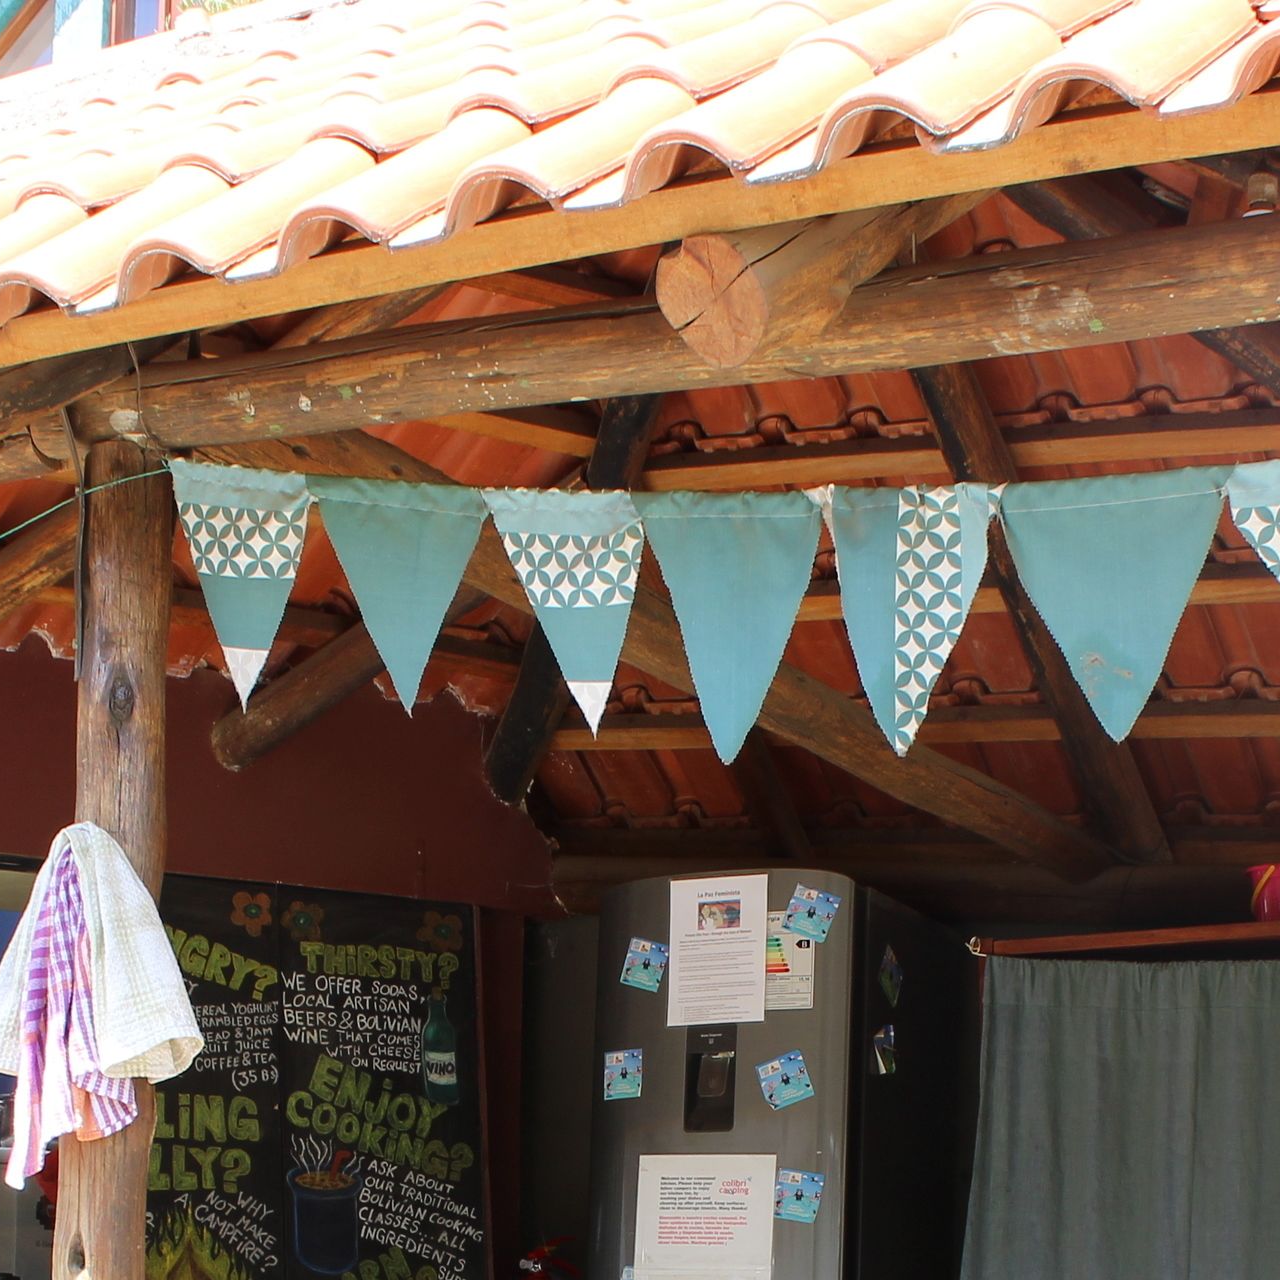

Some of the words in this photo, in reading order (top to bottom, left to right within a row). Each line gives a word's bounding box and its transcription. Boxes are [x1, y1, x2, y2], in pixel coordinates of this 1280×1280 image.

[281, 972, 306, 991] WE
[315, 975, 361, 994] OFFER
[283, 992, 334, 1008] LOCAL
[193, 1004, 227, 1016] EREAL
[284, 1009, 338, 1027] BEERS
[254, 1013, 278, 1025] EGGS
[235, 1028, 244, 1038] &
[246, 1027, 273, 1040] JAM
[336, 1030, 372, 1043] THAT
[377, 1034, 420, 1048] COMES
[369, 1044, 420, 1060] CHEESE
[195, 1056, 238, 1072] COFFEE
[352, 1057, 368, 1067] ON
[373, 1058, 421, 1074] REQUEST
[427, 1062, 455, 1075] VINO
[365, 1177, 394, 1192] OUR
[368, 1159, 398, 1178] ASK
[404, 1171, 454, 1194] ABOUT
[174, 1193, 189, 1208] A
[237, 1192, 274, 1221] WHY
[205, 1191, 236, 1215] NOT
[236, 1216, 276, 1250] MAKE
[438, 1231, 466, 1251] ALL
